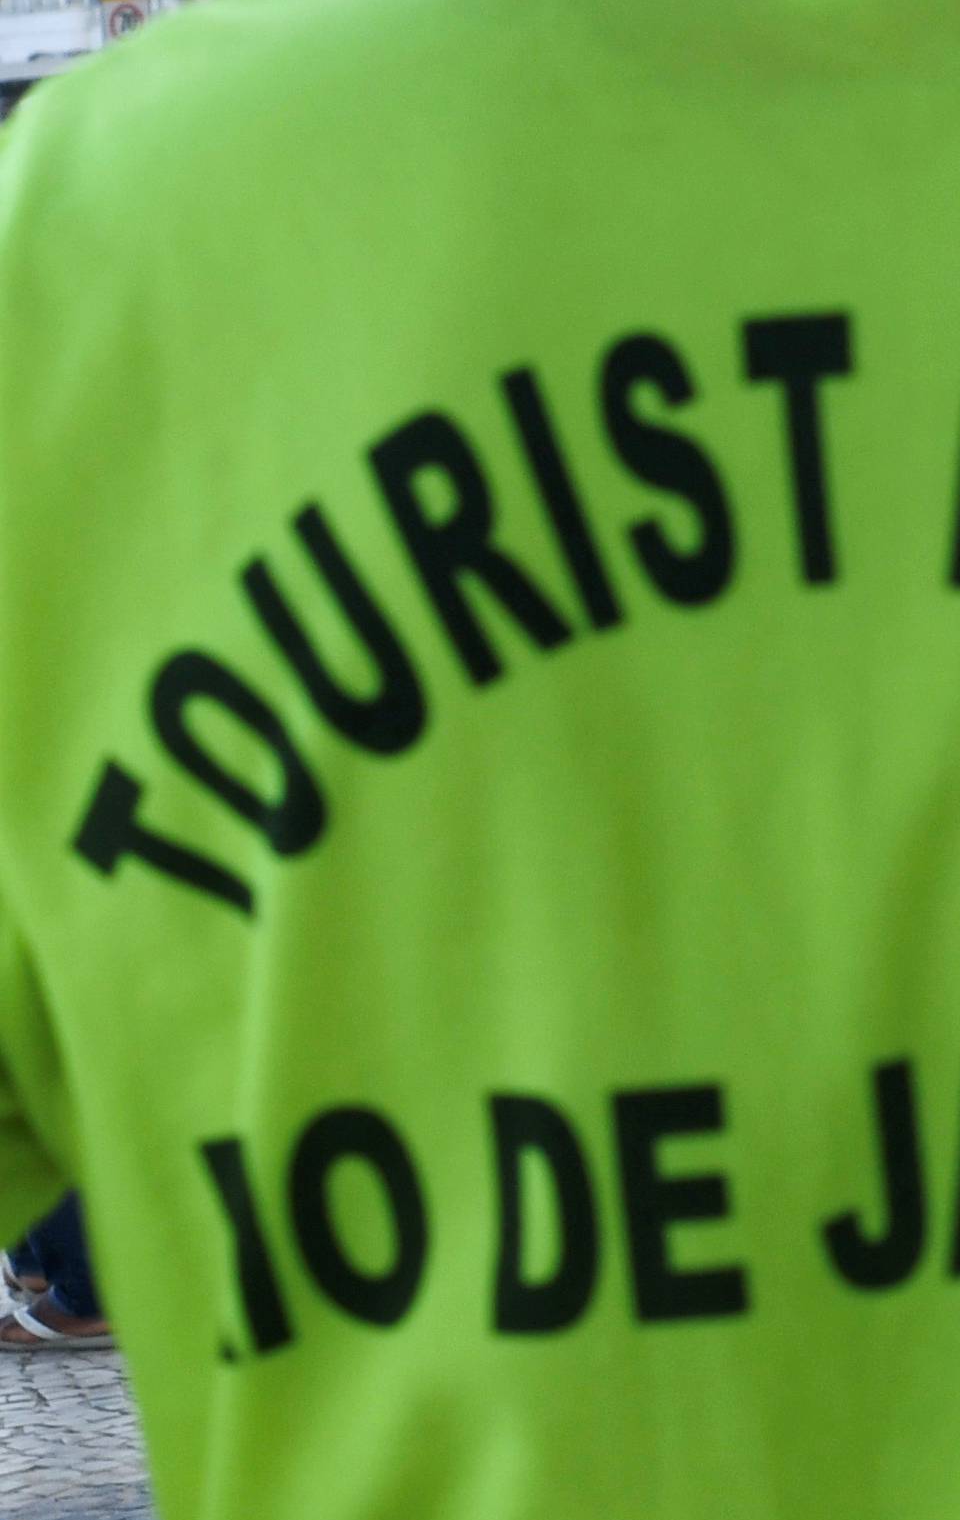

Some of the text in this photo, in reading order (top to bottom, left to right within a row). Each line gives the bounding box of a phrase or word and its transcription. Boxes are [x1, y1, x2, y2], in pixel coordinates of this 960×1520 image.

[70, 310, 855, 917] TOURIST
[198, 1101, 432, 1363] IO
[486, 1079, 754, 1338] DE
